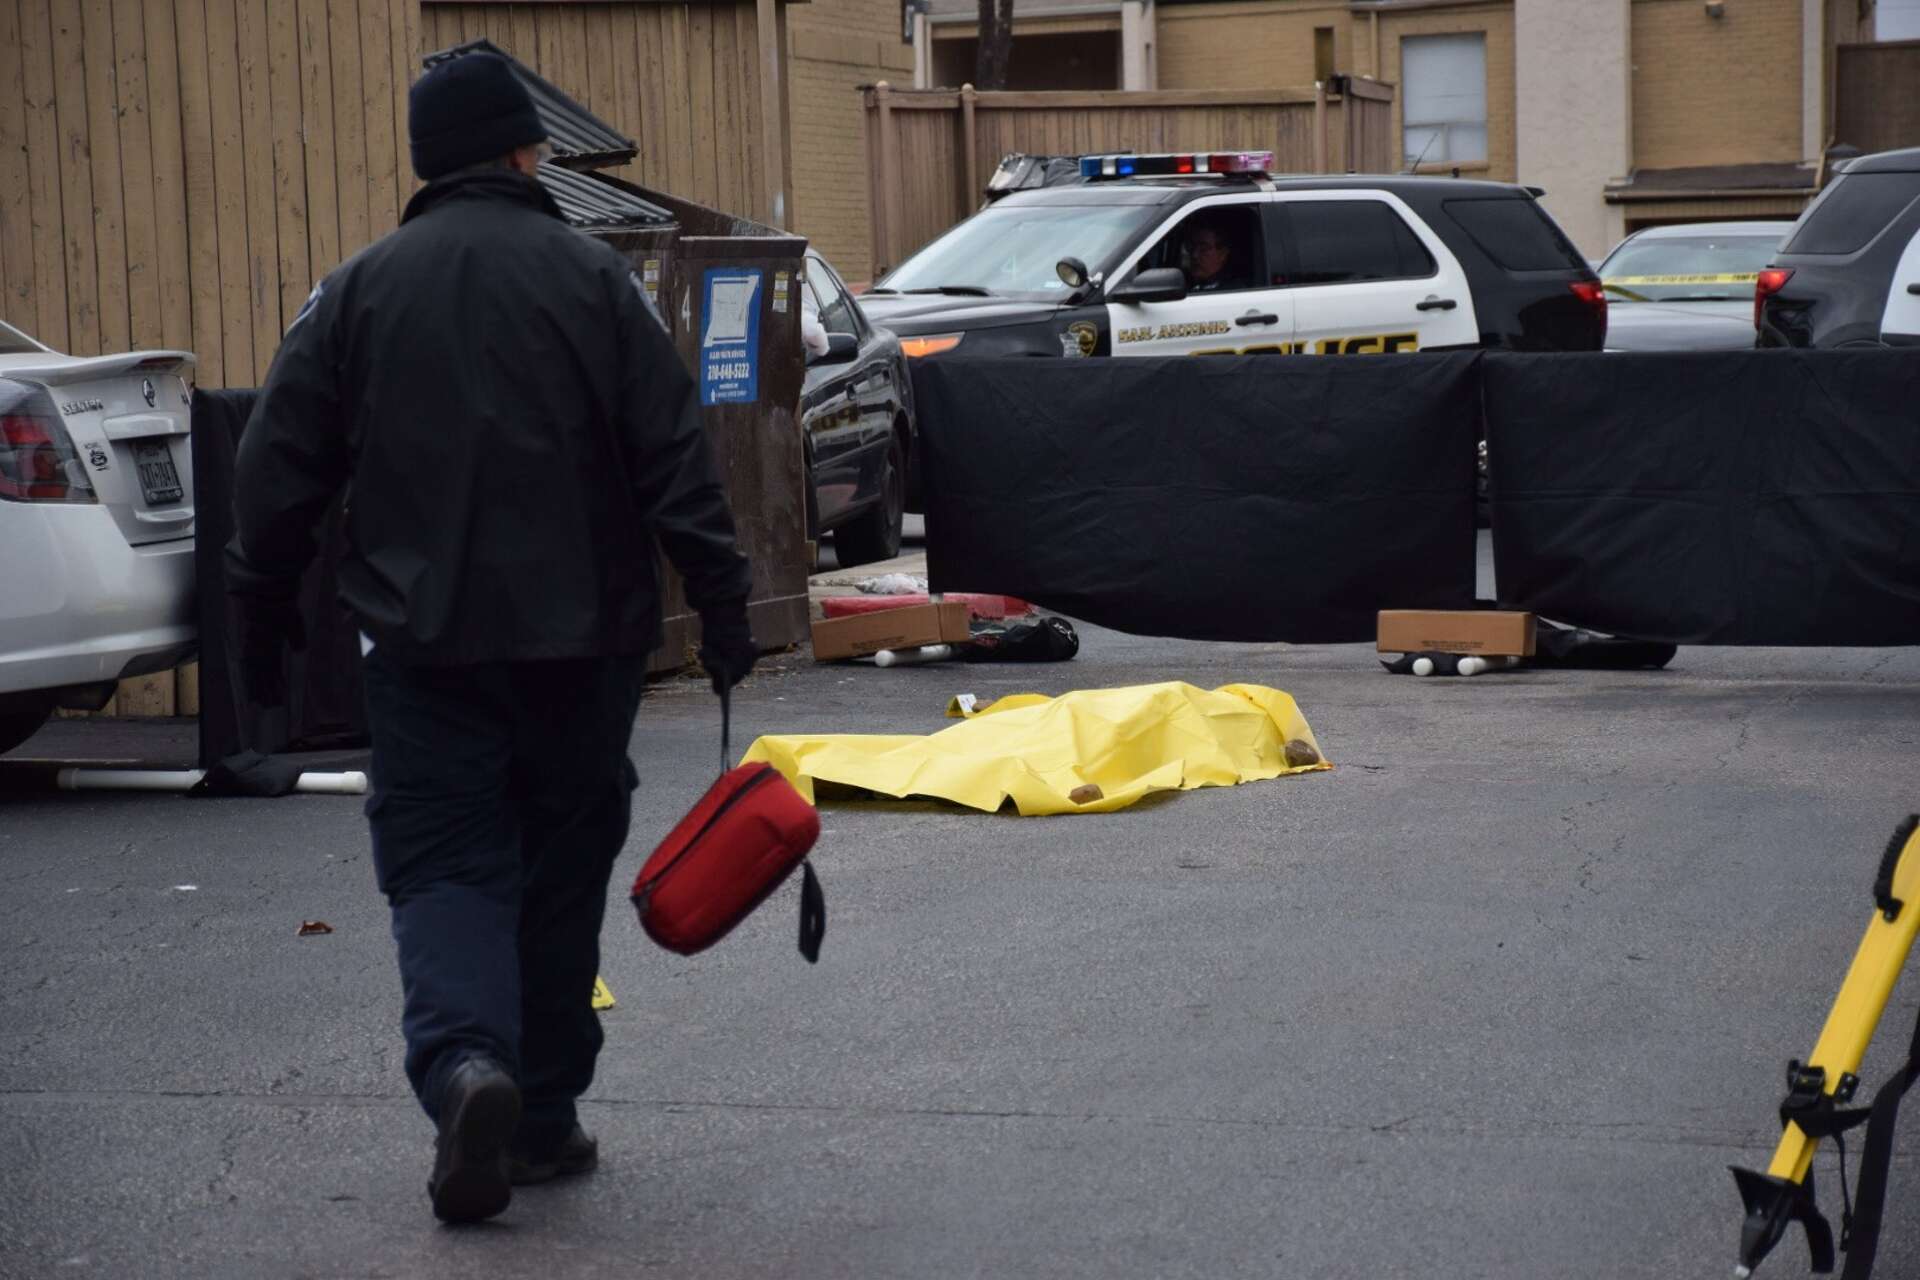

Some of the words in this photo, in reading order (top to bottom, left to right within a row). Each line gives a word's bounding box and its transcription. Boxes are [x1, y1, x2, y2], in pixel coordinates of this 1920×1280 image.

[682, 284, 691, 332] 4
[1118, 326, 1153, 344] SAN
[1157, 320, 1231, 340] ANTONIO
